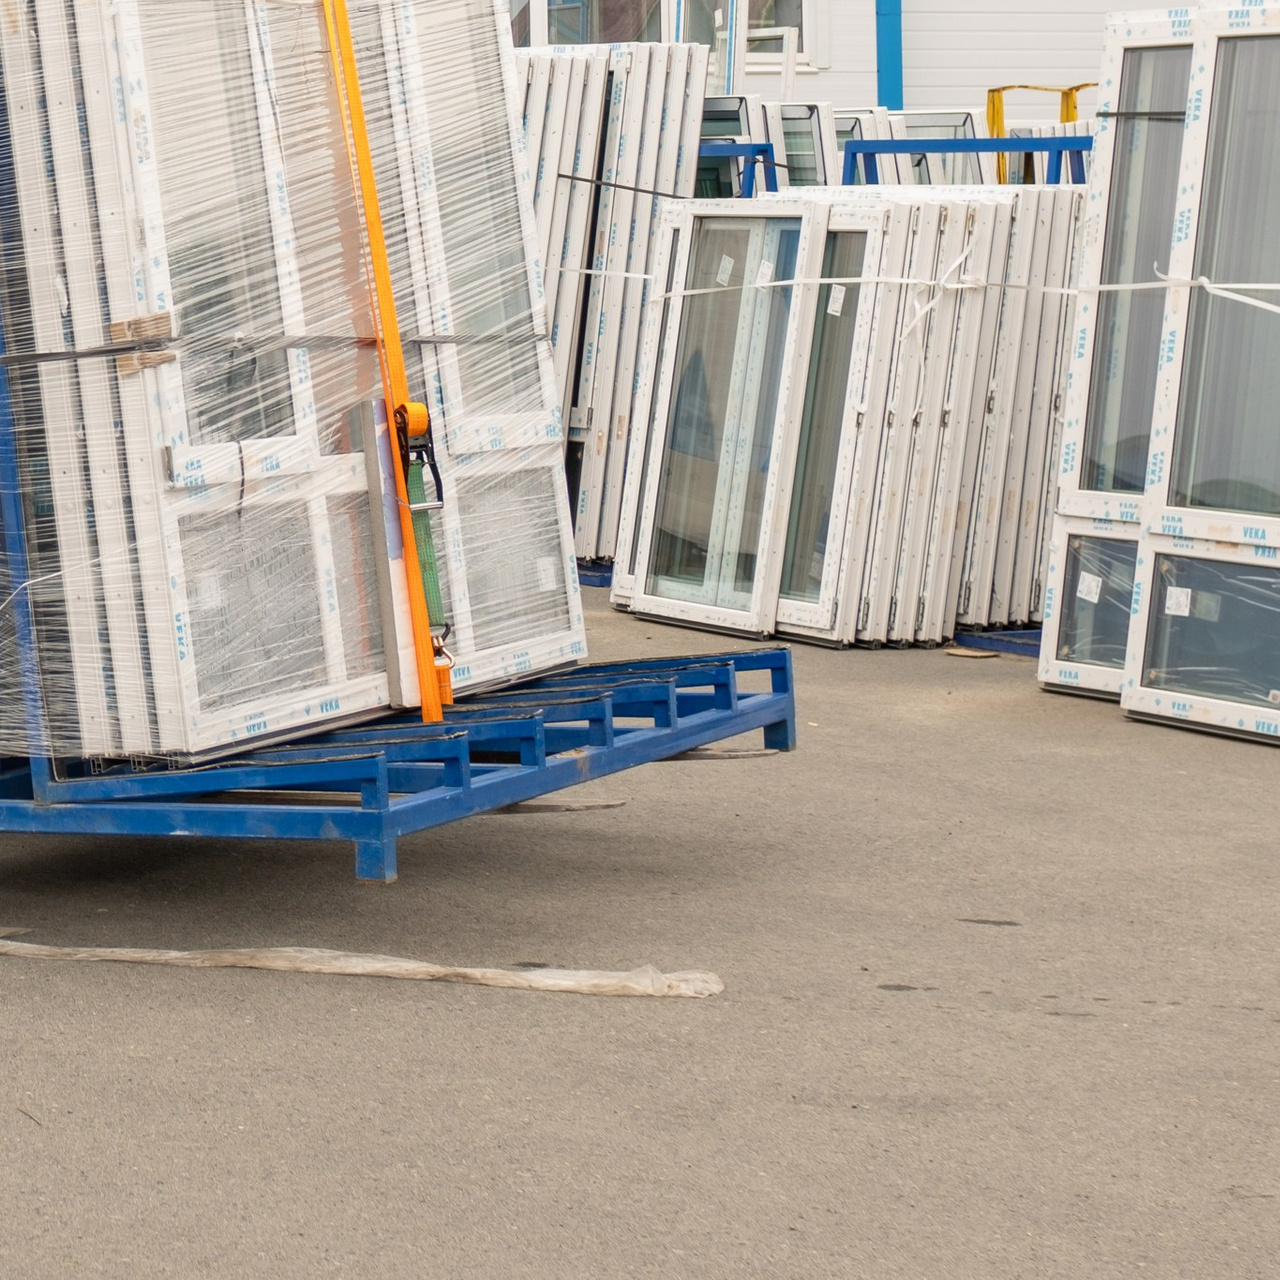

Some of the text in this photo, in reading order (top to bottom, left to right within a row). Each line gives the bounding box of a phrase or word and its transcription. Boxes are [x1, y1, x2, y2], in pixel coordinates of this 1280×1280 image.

[1192, 89, 1202, 121] VEKA
[1176, 210, 1185, 243] VEKA
[1077, 328, 1087, 359] VEKA
[1166, 330, 1176, 363] VEKA
[1062, 443, 1071, 474] VEKA
[1148, 453, 1158, 485] VEKA
[579, 489, 587, 514] VEKA
[1162, 524, 1183, 535] VEKA
[1243, 526, 1266, 540] VEKA
[569, 554, 578, 593] VEKA
[1044, 588, 1053, 619] VEKA
[1131, 582, 1141, 615] VEKA
[175, 613, 186, 661] VEKA
[453, 666, 471, 680] VEKA
[1058, 669, 1079, 680] VEKA
[320, 698, 341, 714] VEKA
[1255, 720, 1279, 734] VEKA
